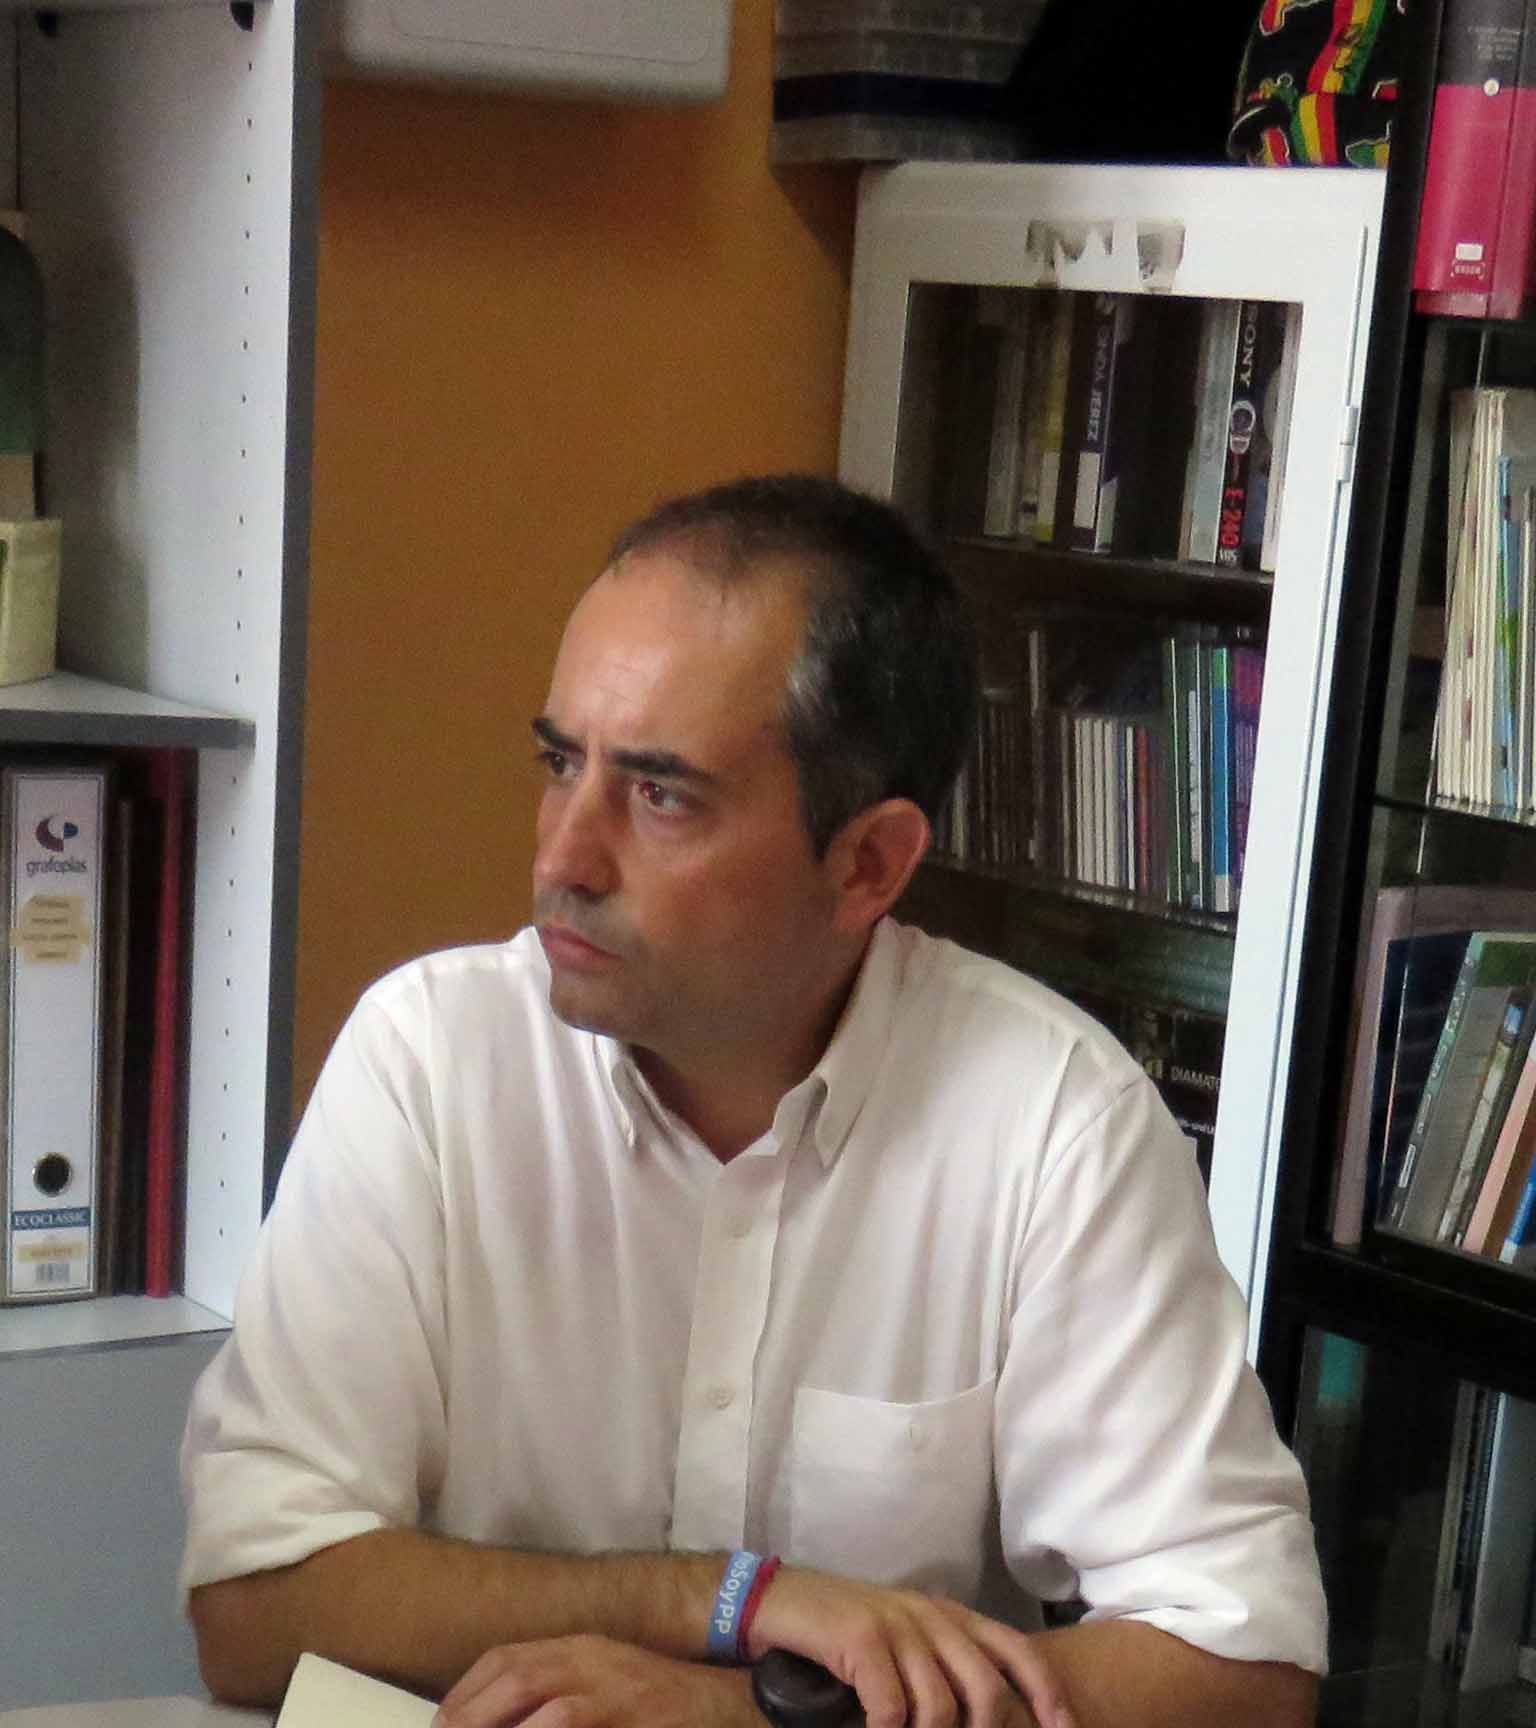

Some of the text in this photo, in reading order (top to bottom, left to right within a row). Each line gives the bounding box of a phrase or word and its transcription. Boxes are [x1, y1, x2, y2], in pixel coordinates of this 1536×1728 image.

[1239, 302, 1258, 389] SONY
[1086, 388, 1104, 442] JEREZ
[25, 855, 88, 877] grafoplas
[15, 1212, 88, 1228] ECOCLASSIC
